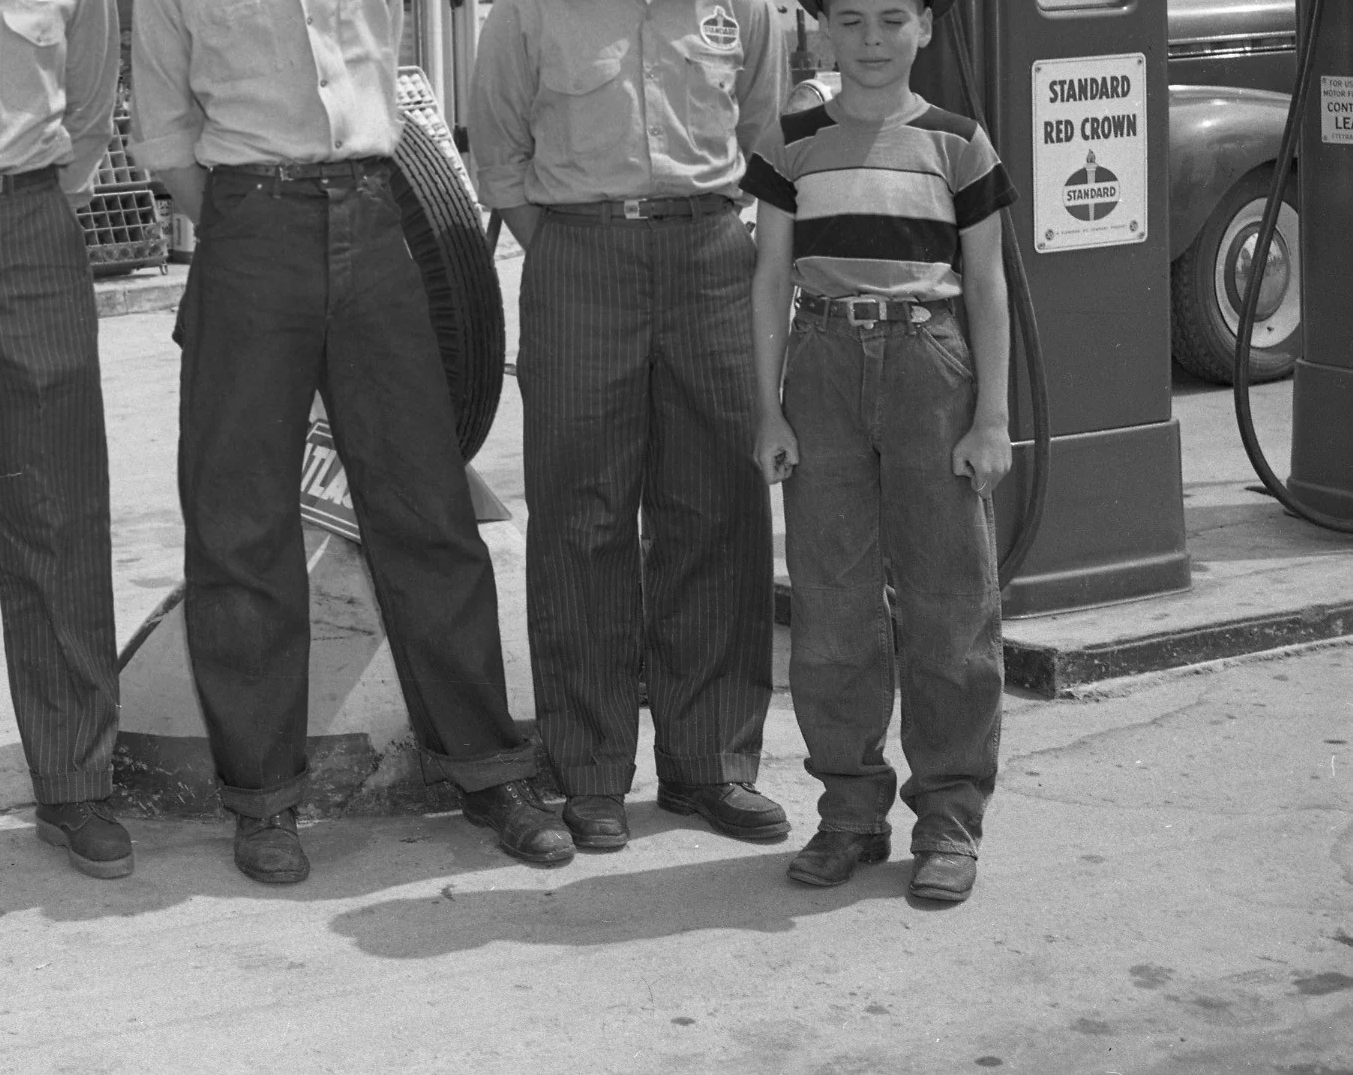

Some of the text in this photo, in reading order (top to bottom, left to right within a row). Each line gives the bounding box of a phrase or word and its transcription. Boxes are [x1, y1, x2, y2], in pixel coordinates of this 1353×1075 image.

[1049, 75, 1131, 103] STANDARD
[1329, 79, 1343, 87] FOR
[1323, 89, 1346, 97] MOTOR
[1327, 102, 1353, 113] CONT
[1044, 113, 1137, 144] RED CROWN
[1335, 116, 1353, 130] LE
[1066, 186, 1116, 201] STANDARD
